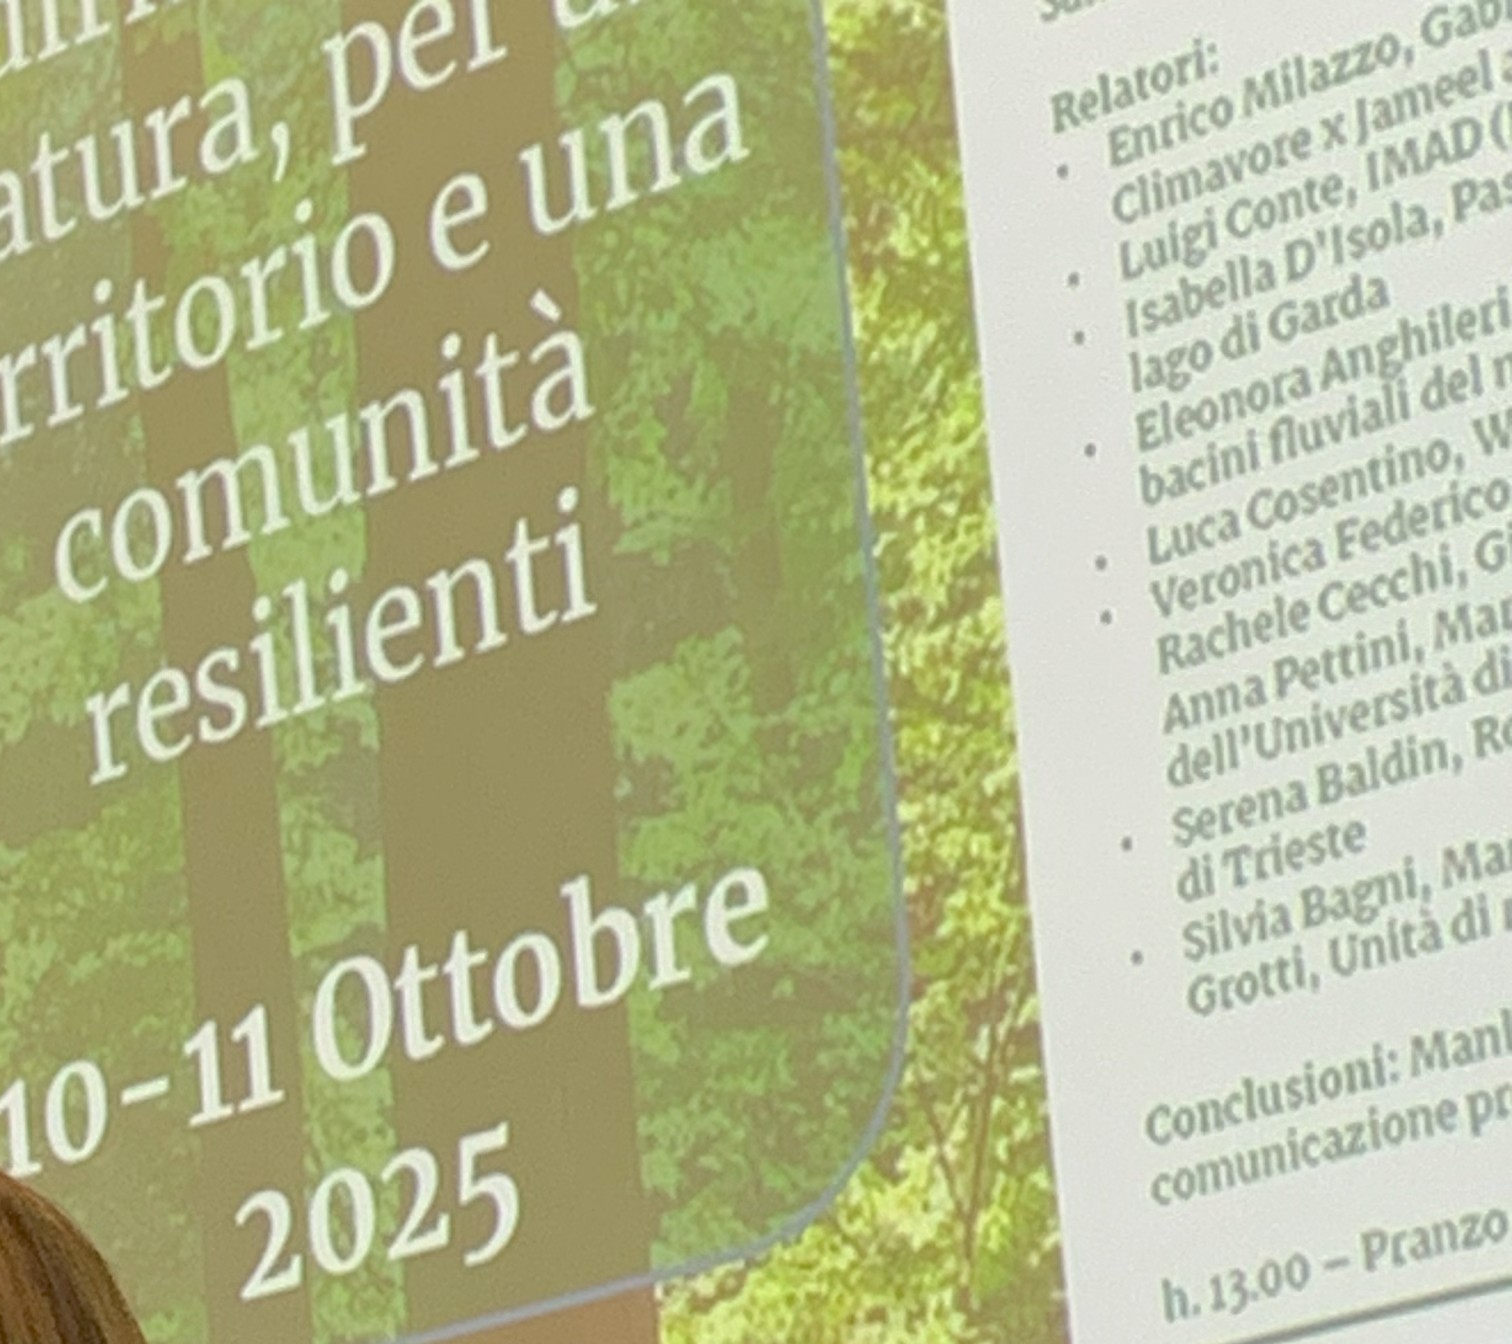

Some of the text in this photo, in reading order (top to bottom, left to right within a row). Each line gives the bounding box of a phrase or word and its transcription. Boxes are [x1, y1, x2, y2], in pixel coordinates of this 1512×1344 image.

[321, 0, 507, 166] per
[1050, 38, 1217, 133] Relatori:
[1107, 96, 1234, 168] Enrico
[1242, 32, 1415, 118] Milazzo,
[1420, 0, 1512, 48] Gab
[1111, 126, 1312, 224] Climavore
[1320, 111, 1348, 149] x
[1356, 48, 1493, 147] Jameel
[429, 170, 490, 272] e
[521, 69, 749, 236] una
[1120, 206, 1218, 281] Luigi
[1225, 172, 1357, 239] Conte,
[1366, 116, 1483, 192] IMAD
[1126, 255, 1276, 338] Isabella
[1286, 200, 1443, 283] D'Isola,
[1129, 272, 1390, 394] lago di Garda
[1135, 285, 1511, 452] Eleonora Anghileri
[1139, 428, 1260, 505] bacini
[1269, 377, 1410, 465] fluviali
[1421, 353, 1484, 413] del
[54, 289, 594, 604] comunità
[1146, 507, 1241, 565] Luca
[1246, 438, 1465, 530] Cosentino,
[1150, 477, 1511, 618] Veronica Federico
[1157, 594, 1311, 675] Rachele
[1318, 542, 1469, 622] Cecchi,
[87, 487, 598, 787] resilienti
[1162, 672, 1268, 735] Anna
[1274, 617, 1425, 699] Pettini,
[1166, 660, 1467, 788] dell'Università
[1172, 777, 1309, 849] Serena
[1316, 734, 1464, 805] Baldin,
[1177, 819, 1367, 901] di Trieste
[1182, 898, 1291, 963] Silvia
[1300, 853, 1432, 929] Bagni,
[1441, 835, 1512, 888] Ma
[311, 867, 771, 1082] Ottobre
[1188, 942, 1321, 1017] Grotti,
[1328, 905, 1443, 977] Unità
[1450, 891, 1490, 944] di
[1145, 1042, 1399, 1147] Conclusioni:
[1150, 1097, 1459, 1206] comunicazione
[236, 1122, 520, 1300] 2025
[1160, 1276, 1202, 1324] h.
[1210, 1253, 1310, 1315] 13.00
[1360, 1209, 1509, 1272] Pranzo
